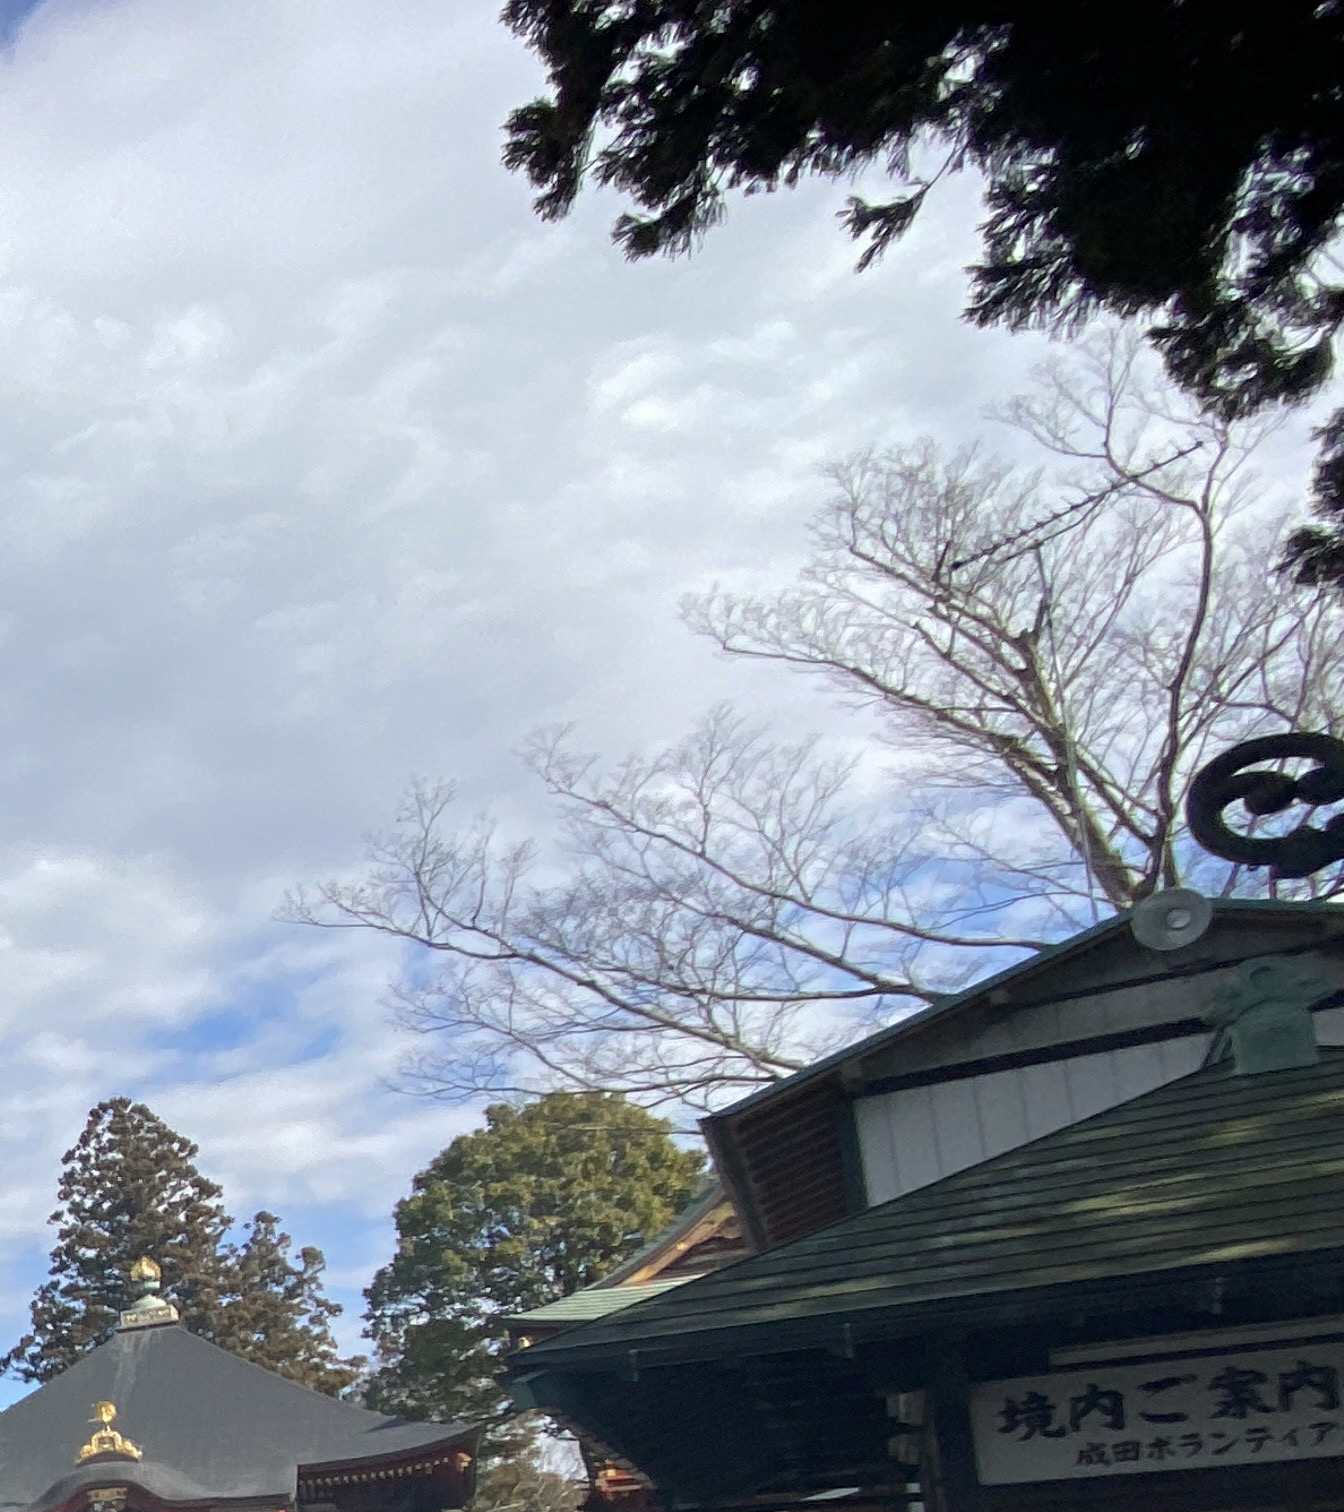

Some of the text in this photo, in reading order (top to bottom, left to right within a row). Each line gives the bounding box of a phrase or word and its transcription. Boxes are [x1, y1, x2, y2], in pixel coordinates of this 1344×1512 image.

[997, 1359, 1340, 1441] 境内ご案内
